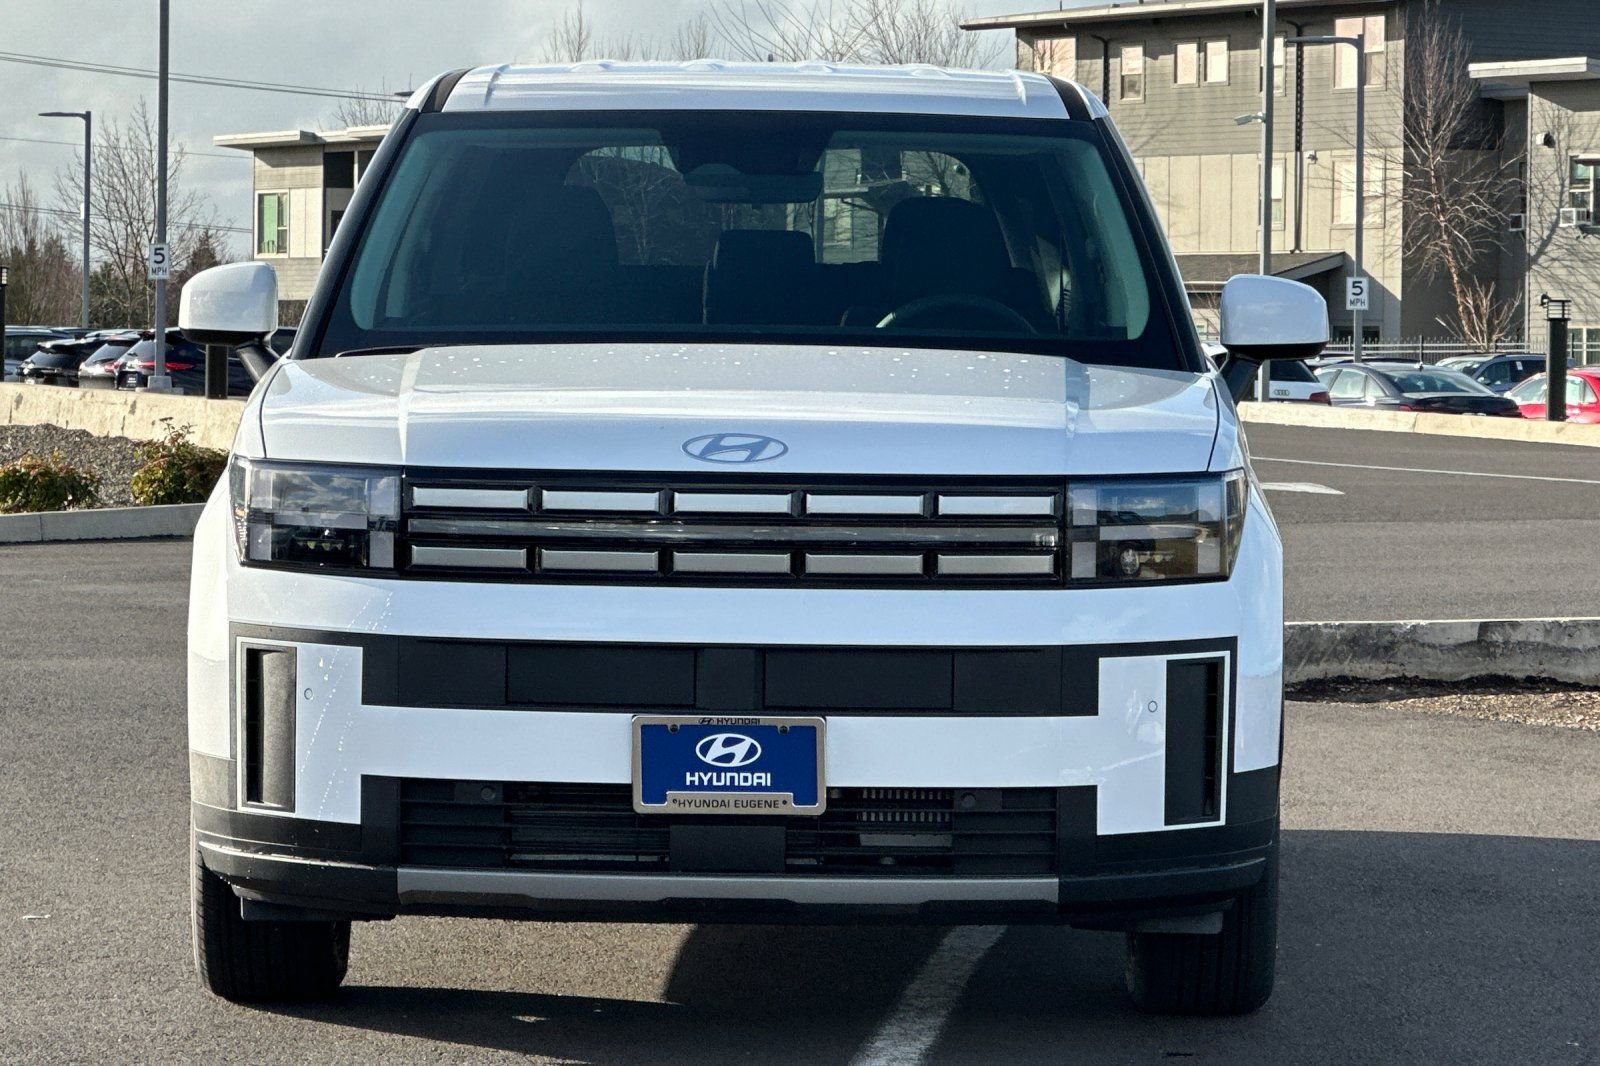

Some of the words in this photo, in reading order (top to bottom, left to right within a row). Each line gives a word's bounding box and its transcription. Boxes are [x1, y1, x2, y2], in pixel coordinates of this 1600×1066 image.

[153, 247, 165, 264] 5
[151, 266, 167, 275] MPH
[1351, 280, 1363, 296] 5
[1349, 298, 1366, 307] MPH
[716, 717, 761, 726] HYUNDAI
[685, 771, 771, 787] HYUNDAI
[678, 799, 730, 809] HYUNDAI
[734, 799, 780, 809] EUGENE
